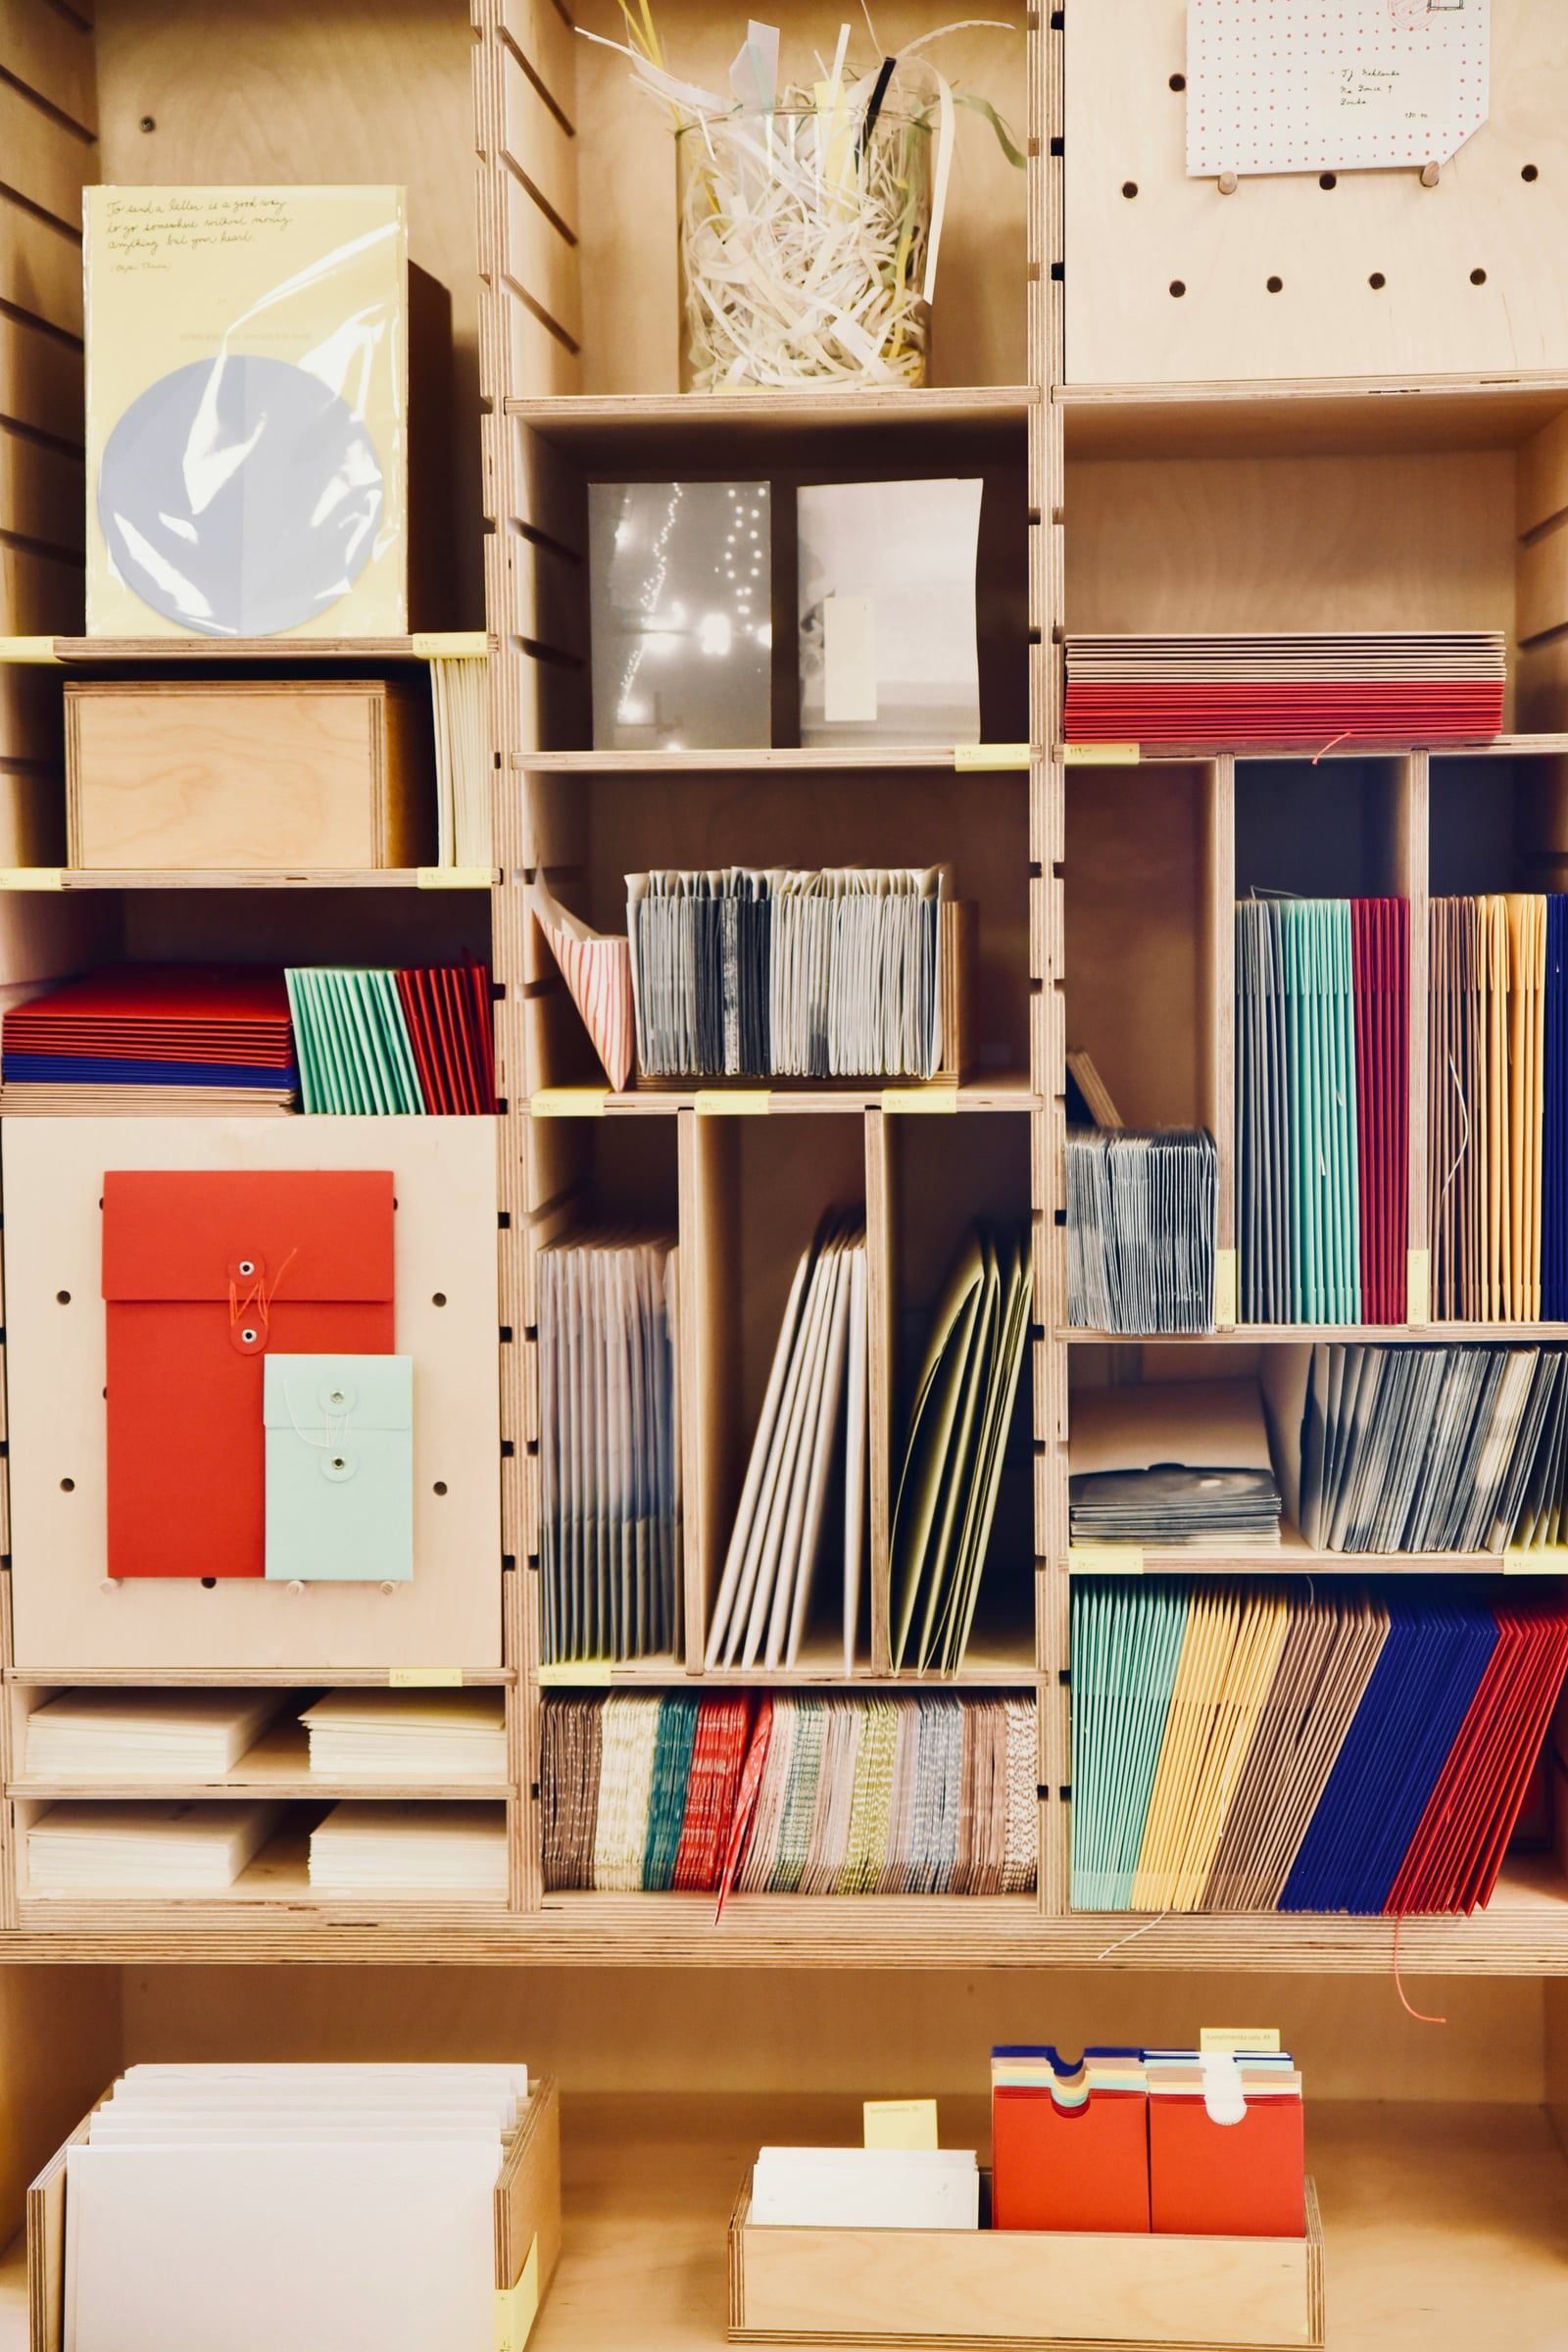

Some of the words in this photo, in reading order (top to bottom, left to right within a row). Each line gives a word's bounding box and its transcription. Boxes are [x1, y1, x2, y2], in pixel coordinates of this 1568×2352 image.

[107, 200, 123, 217] To
[126, 199, 153, 214] send
[156, 205, 165, 214] a
[170, 198, 203, 212] letter
[221, 201, 231, 210] a
[233, 196, 258, 214] good
[260, 199, 287, 215] way
[106, 221, 122, 234] to
[123, 224, 137, 239] go
[144, 219, 198, 232] somewhere
[205, 216, 247, 227] without
[108, 238, 159, 255] anything
[167, 234, 188, 245] but
[191, 236, 218, 251] your
